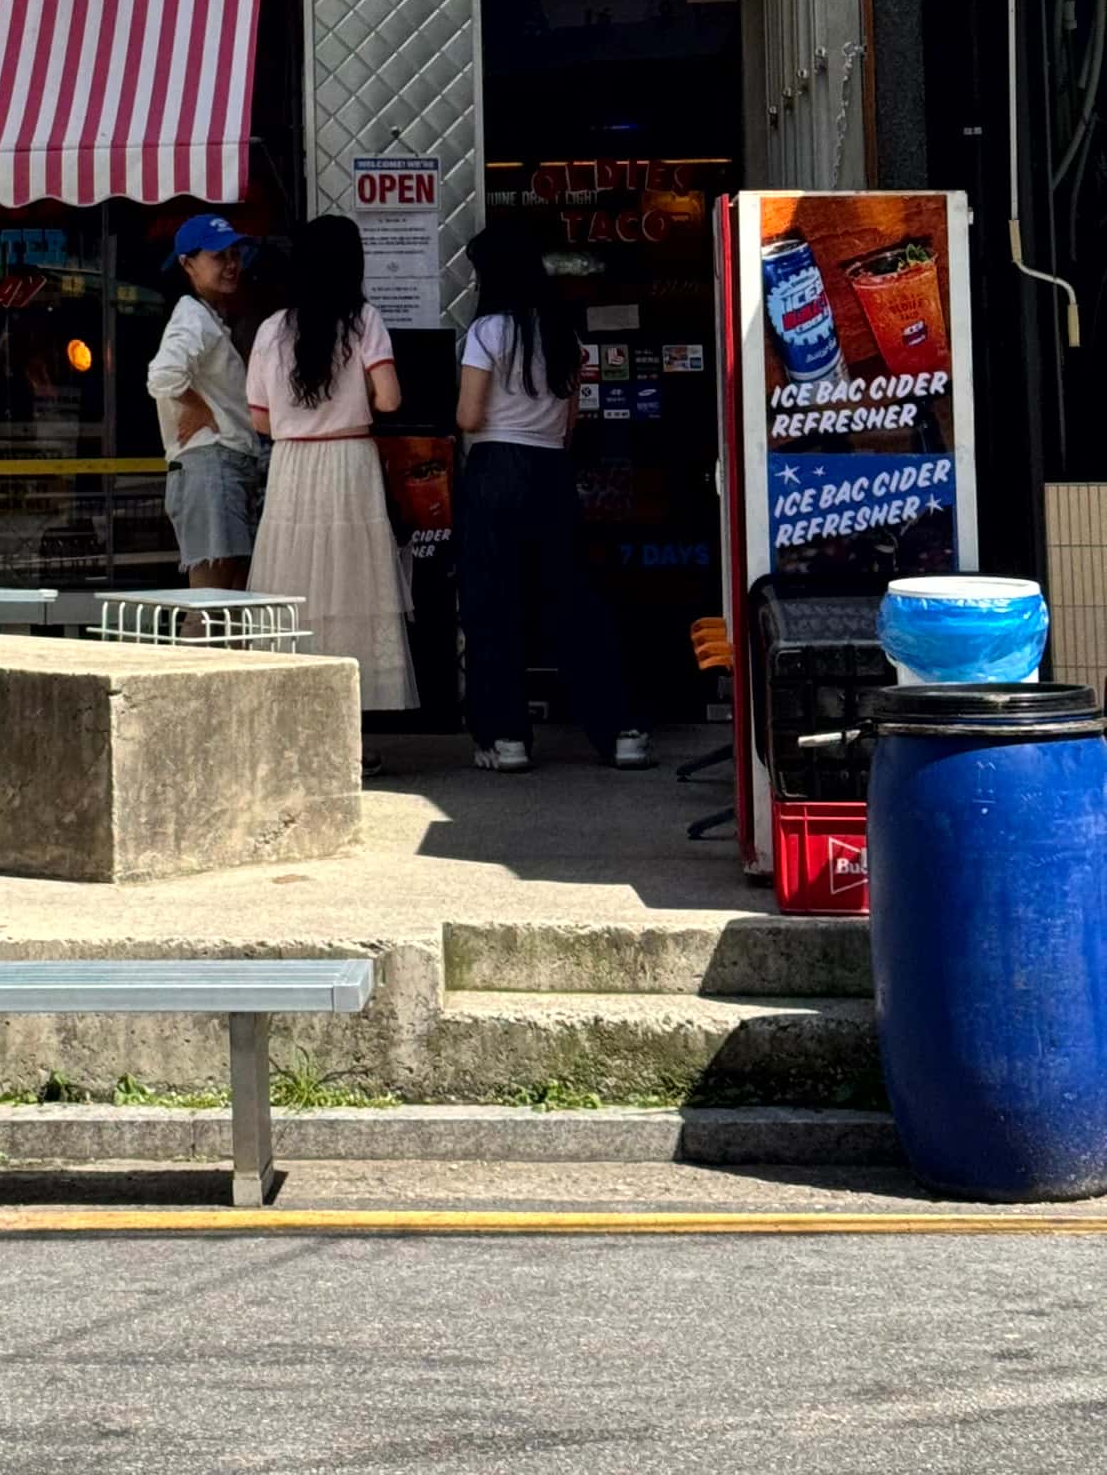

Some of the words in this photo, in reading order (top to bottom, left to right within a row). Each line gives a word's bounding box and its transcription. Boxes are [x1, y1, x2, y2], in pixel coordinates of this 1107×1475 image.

[357, 173, 435, 204] OPEN
[559, 208, 671, 244] TACO
[771, 380, 813, 409] ICE
[815, 377, 866, 405] BAC
[869, 371, 949, 401] CIDER
[771, 404, 918, 439] REFRESHER
[774, 488, 817, 519] ICE
[819, 476, 869, 510] BAC
[872, 459, 952, 497] CIDER
[411, 527, 452, 543] CIDER
[774, 495, 921, 549] REFRESHER
[642, 542, 710, 566] DAYS
